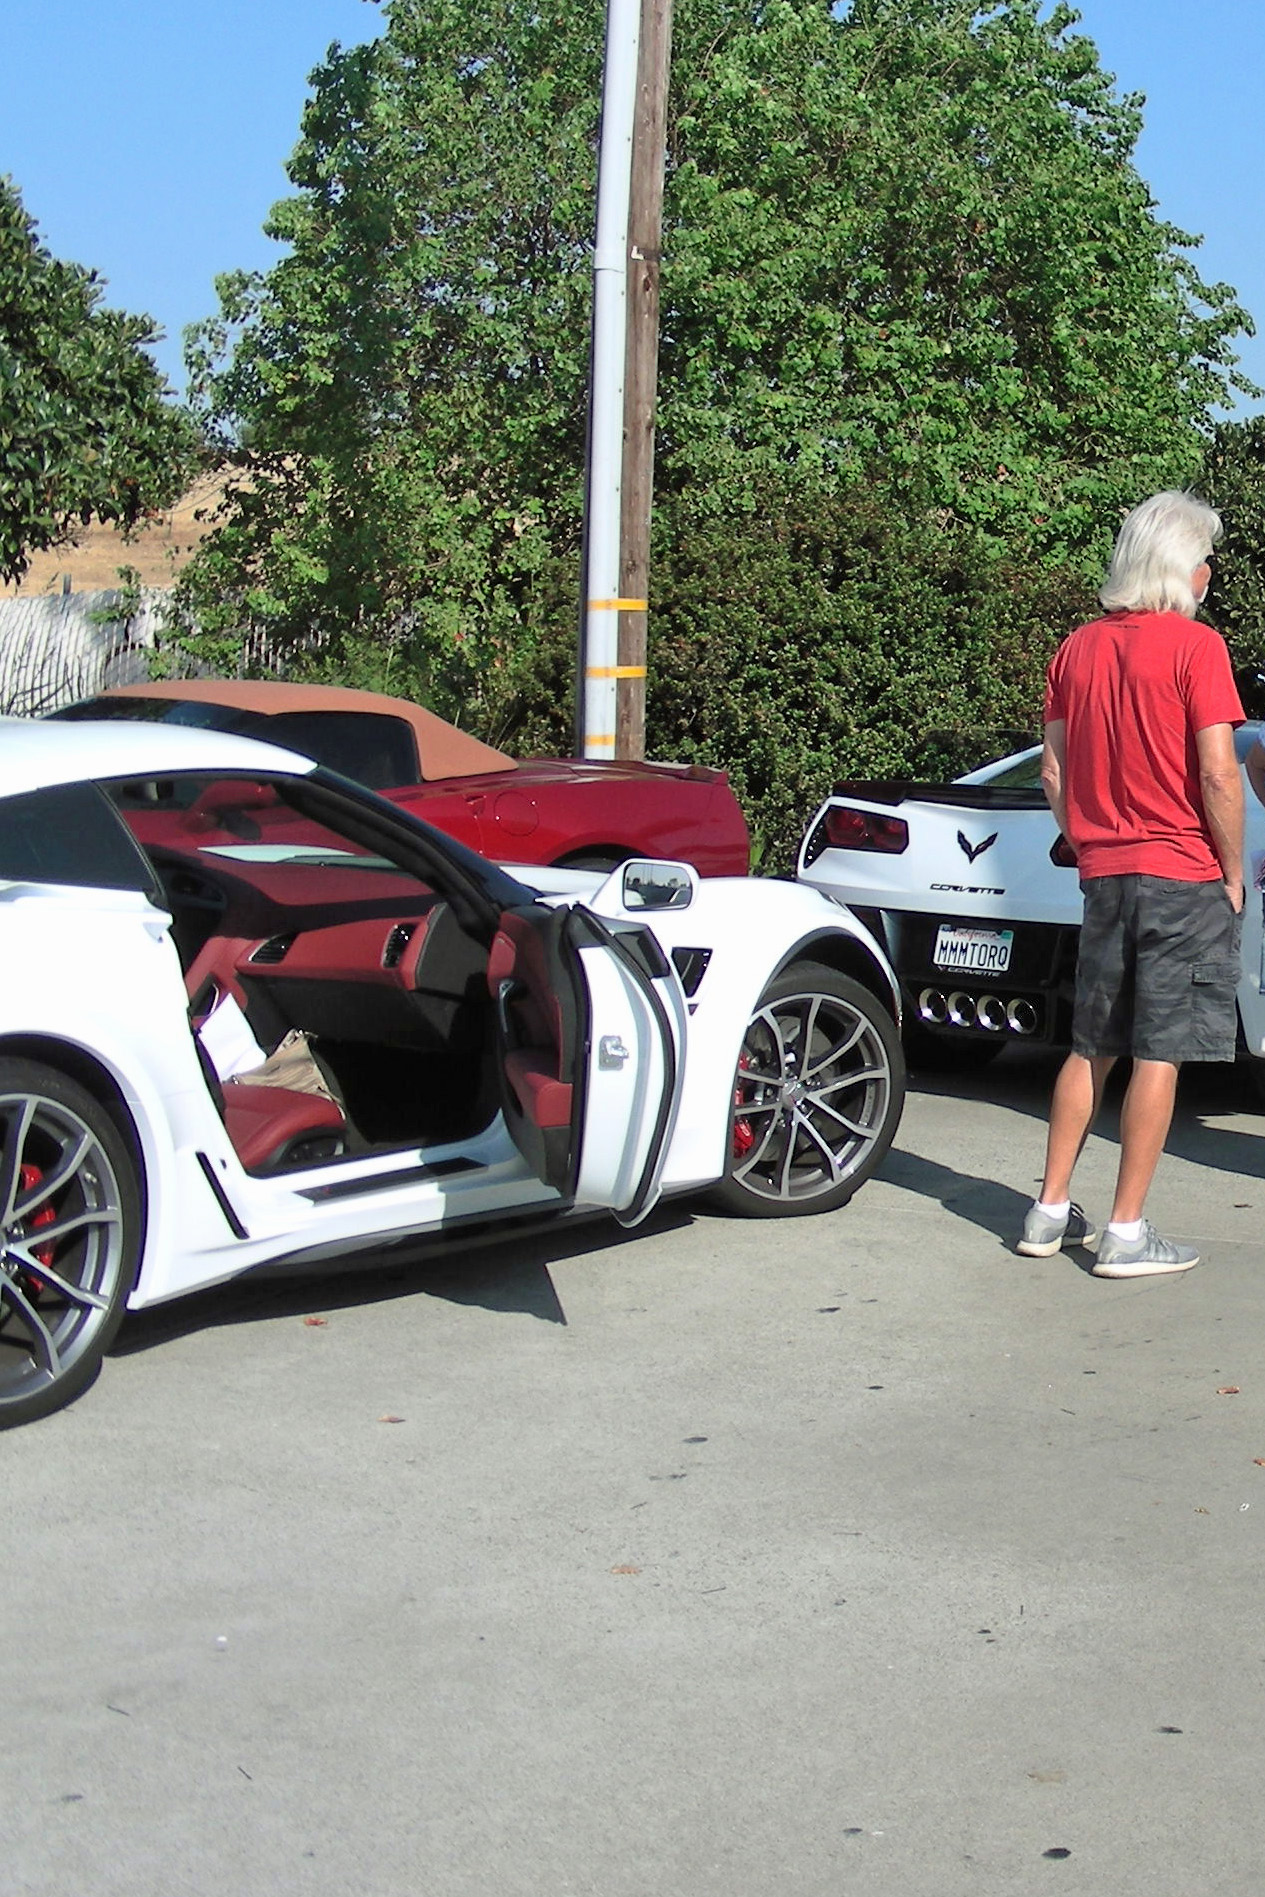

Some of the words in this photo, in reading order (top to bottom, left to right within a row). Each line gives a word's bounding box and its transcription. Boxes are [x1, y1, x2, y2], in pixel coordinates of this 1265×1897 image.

[930, 884, 1005, 895] CORVETTE
[937, 939, 1009, 969] MMMTORQ
[948, 967, 1001, 977] CORVETTE
